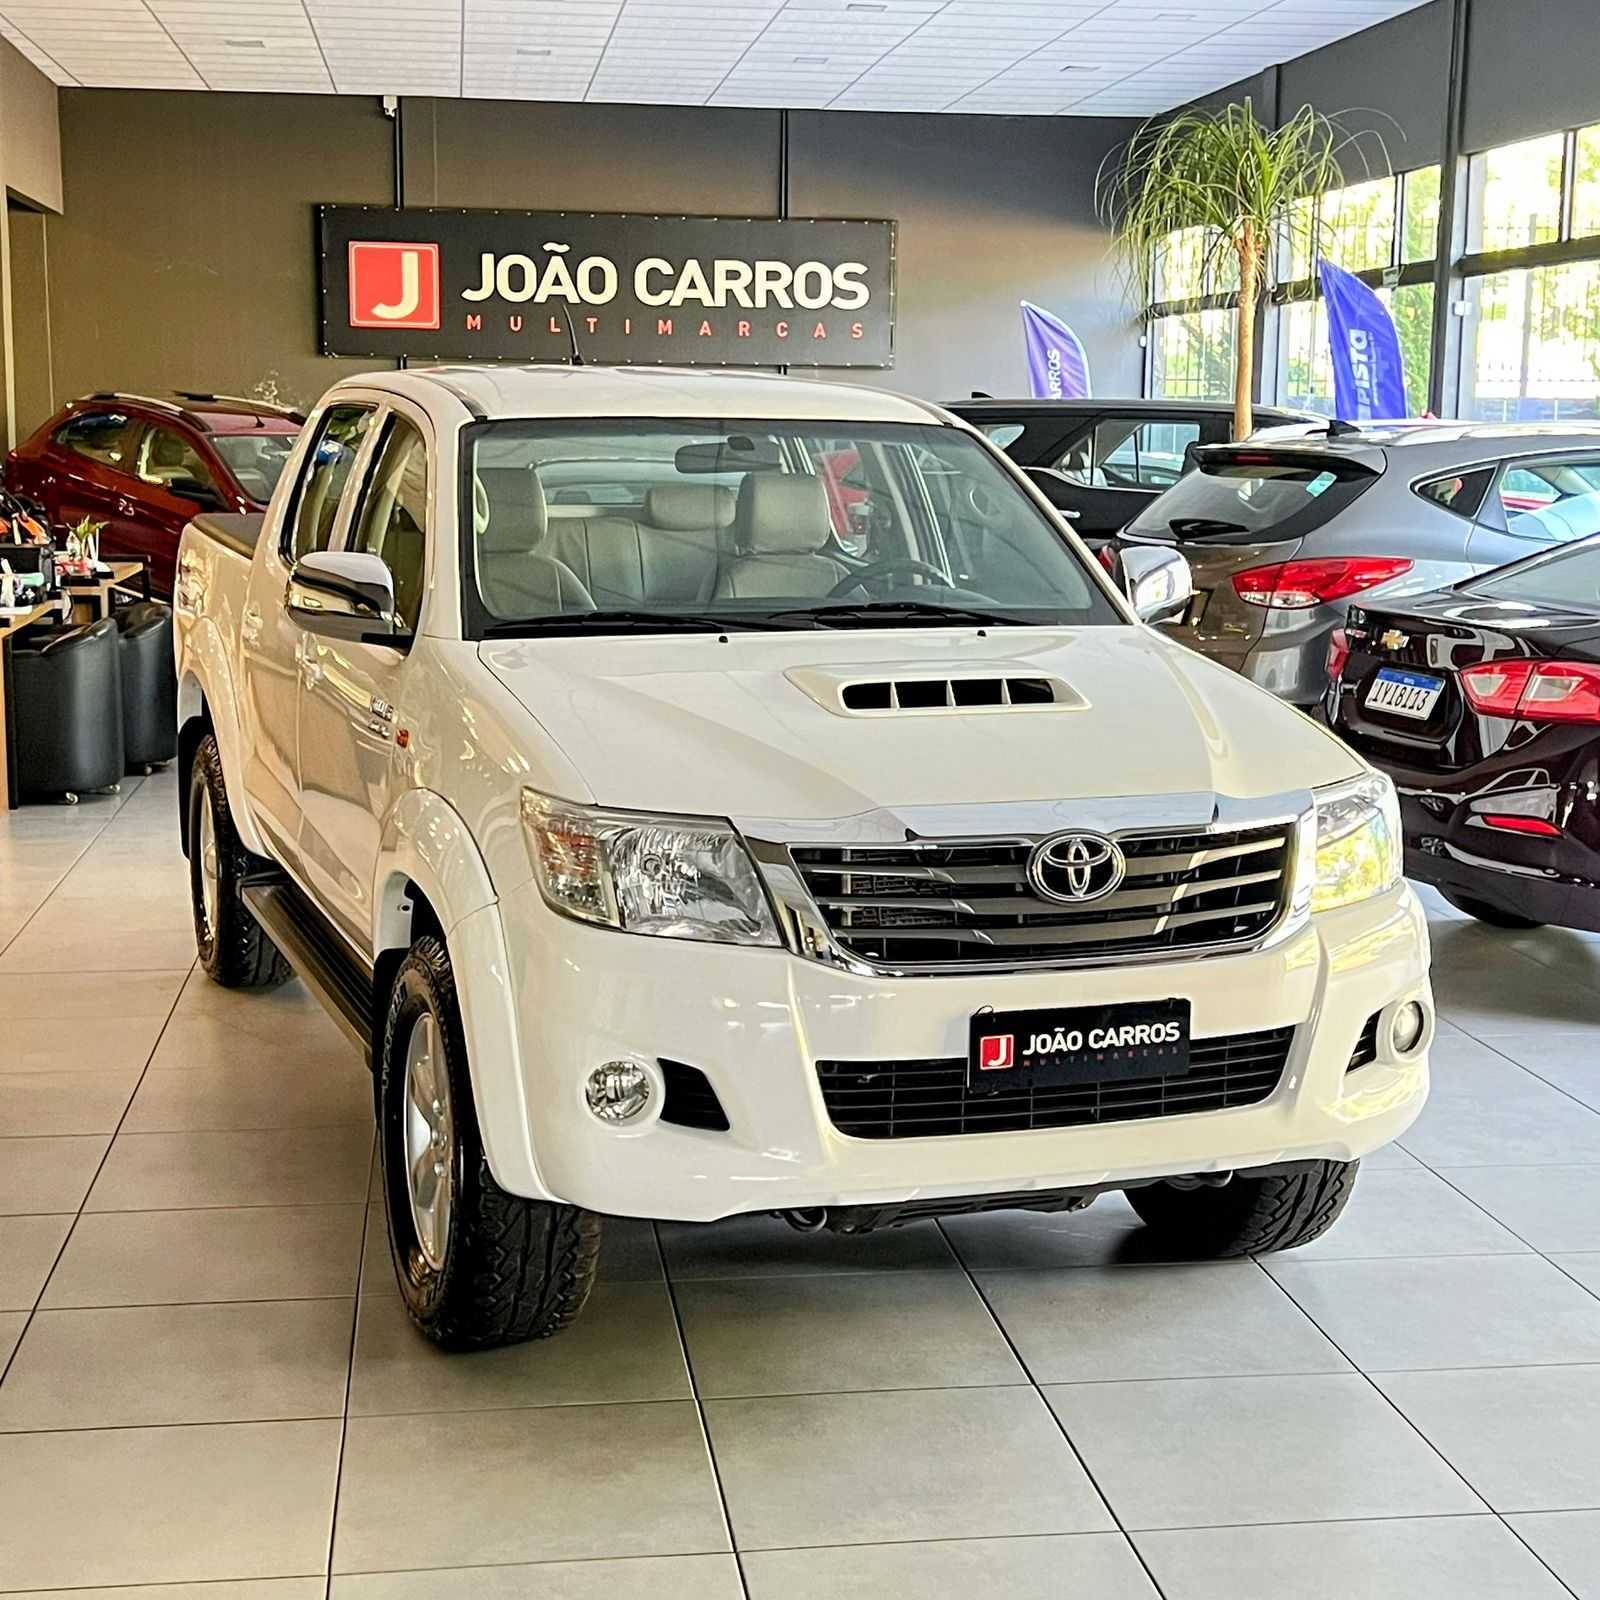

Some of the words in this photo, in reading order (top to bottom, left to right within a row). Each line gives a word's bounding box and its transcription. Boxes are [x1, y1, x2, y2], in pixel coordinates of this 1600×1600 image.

[371, 251, 419, 320] J
[460, 241, 619, 306] JOÃO
[633, 257, 871, 310] CARROS
[466, 313, 864, 339] MULTIMARCAS
[1022, 1027, 1083, 1056] JOÃO
[1088, 1021, 1181, 1049] CARROS
